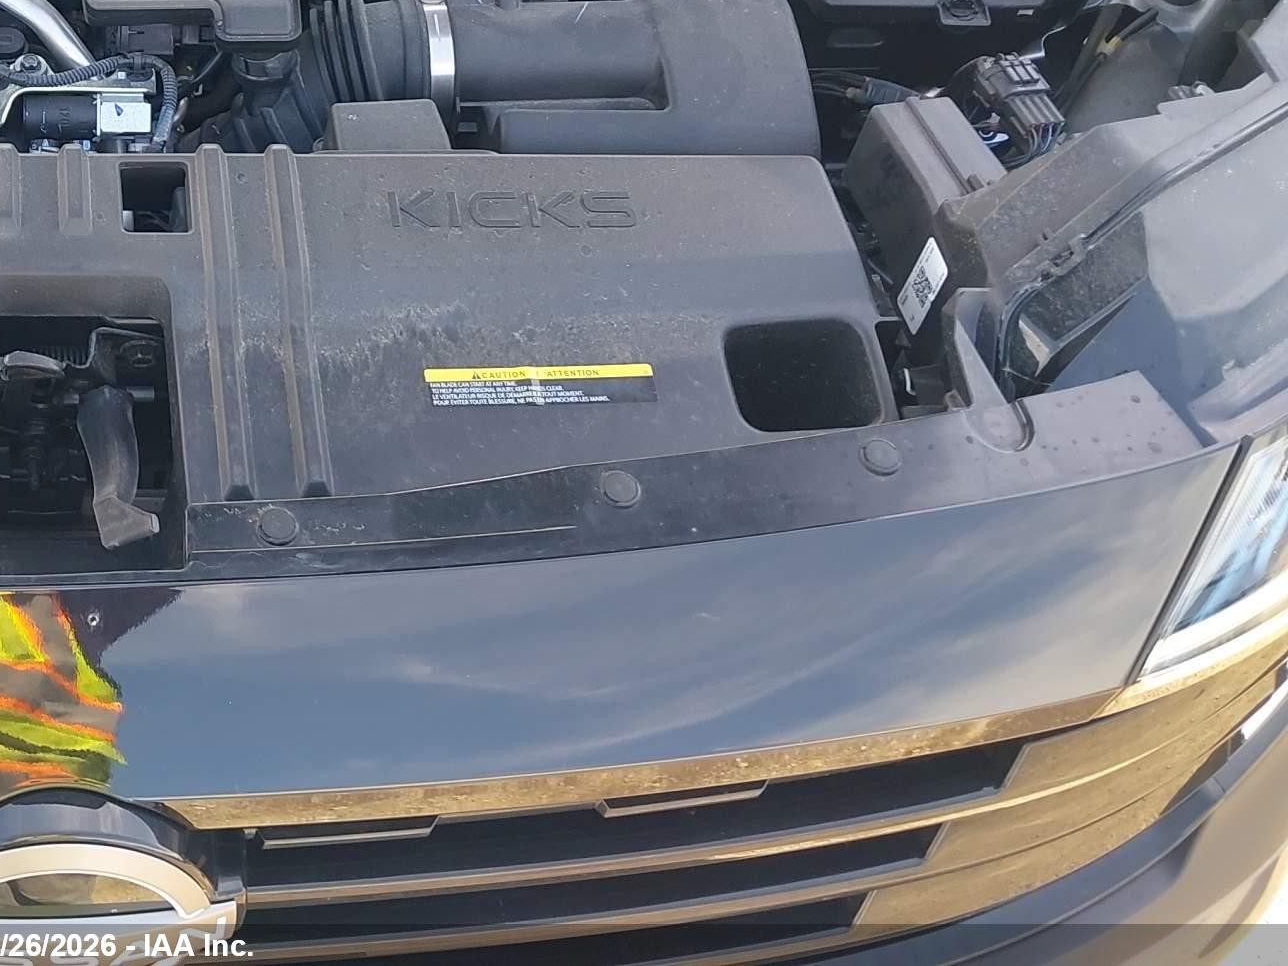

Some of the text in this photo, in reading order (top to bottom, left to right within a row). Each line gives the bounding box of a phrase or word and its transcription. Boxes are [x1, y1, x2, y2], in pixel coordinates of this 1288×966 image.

[386, 190, 636, 229] KICKS
[481, 369, 600, 380] CAUTION ATTENTION
